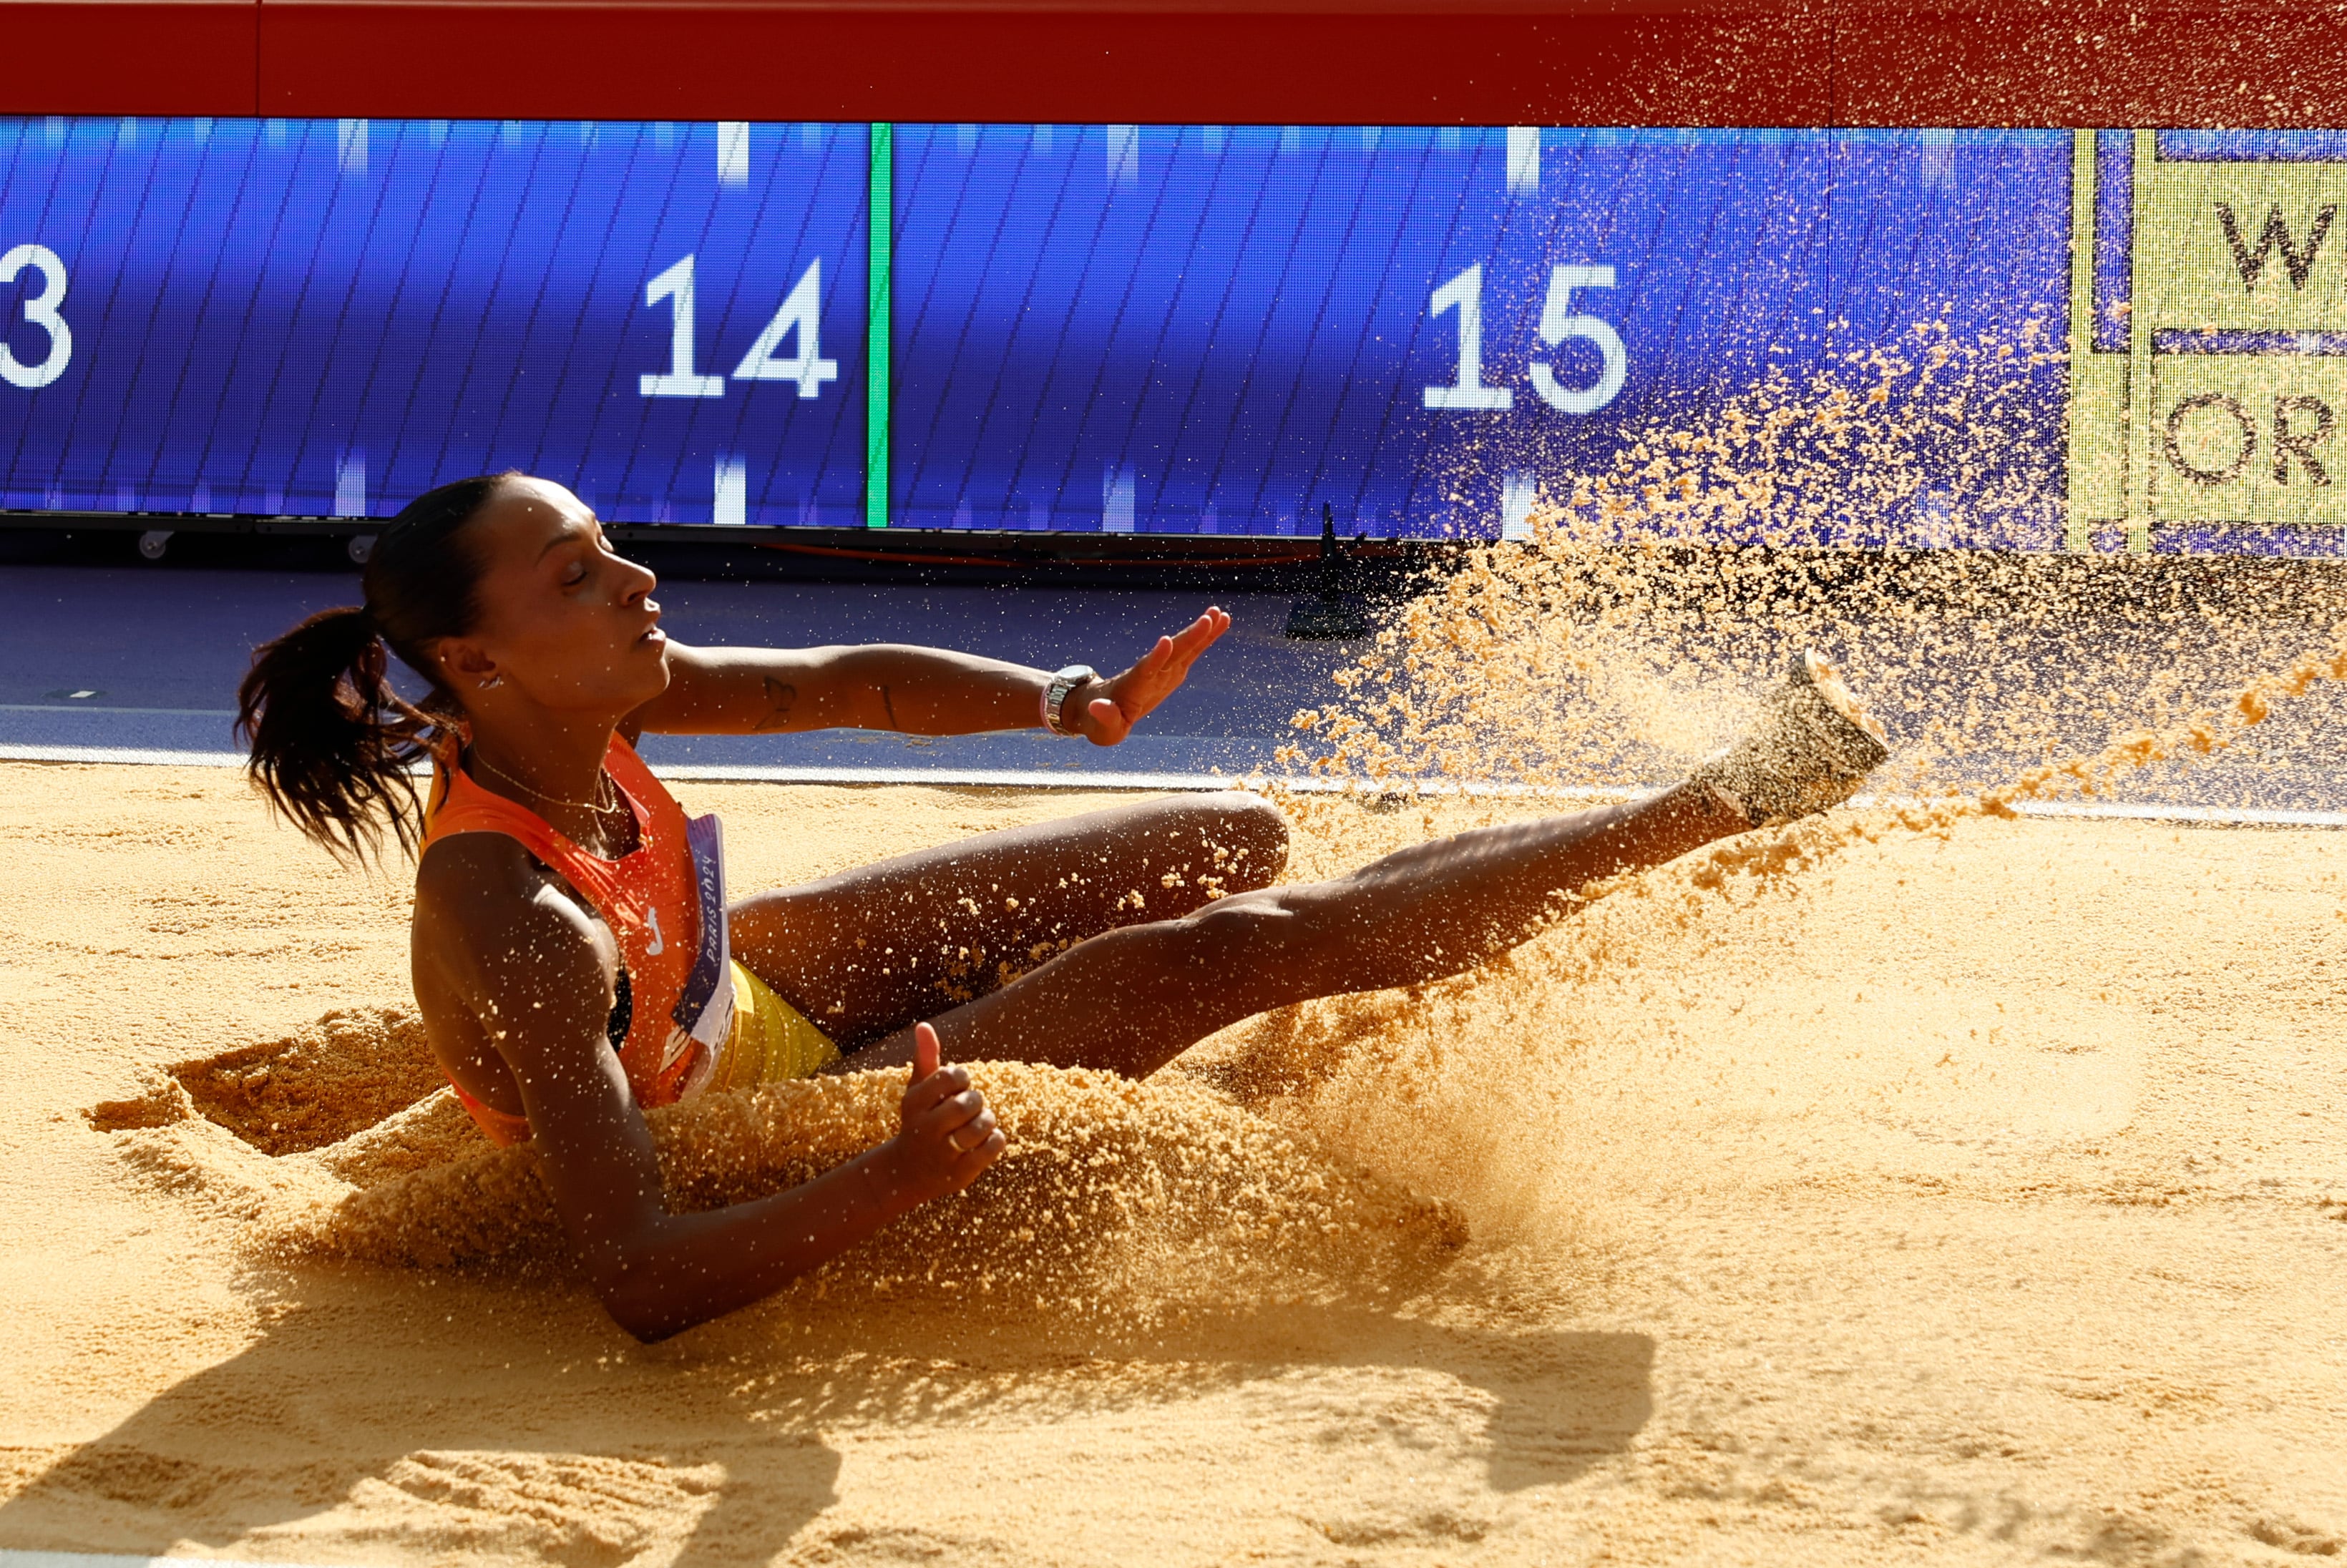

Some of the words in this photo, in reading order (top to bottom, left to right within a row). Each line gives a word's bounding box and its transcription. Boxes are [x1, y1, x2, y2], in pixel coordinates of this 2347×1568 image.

[640, 253, 837, 399] 14
[1424, 263, 1626, 414] 15
[2165, 393, 2333, 486] OR
[701, 856, 716, 905] 2024
[706, 906, 718, 963] PARIS
